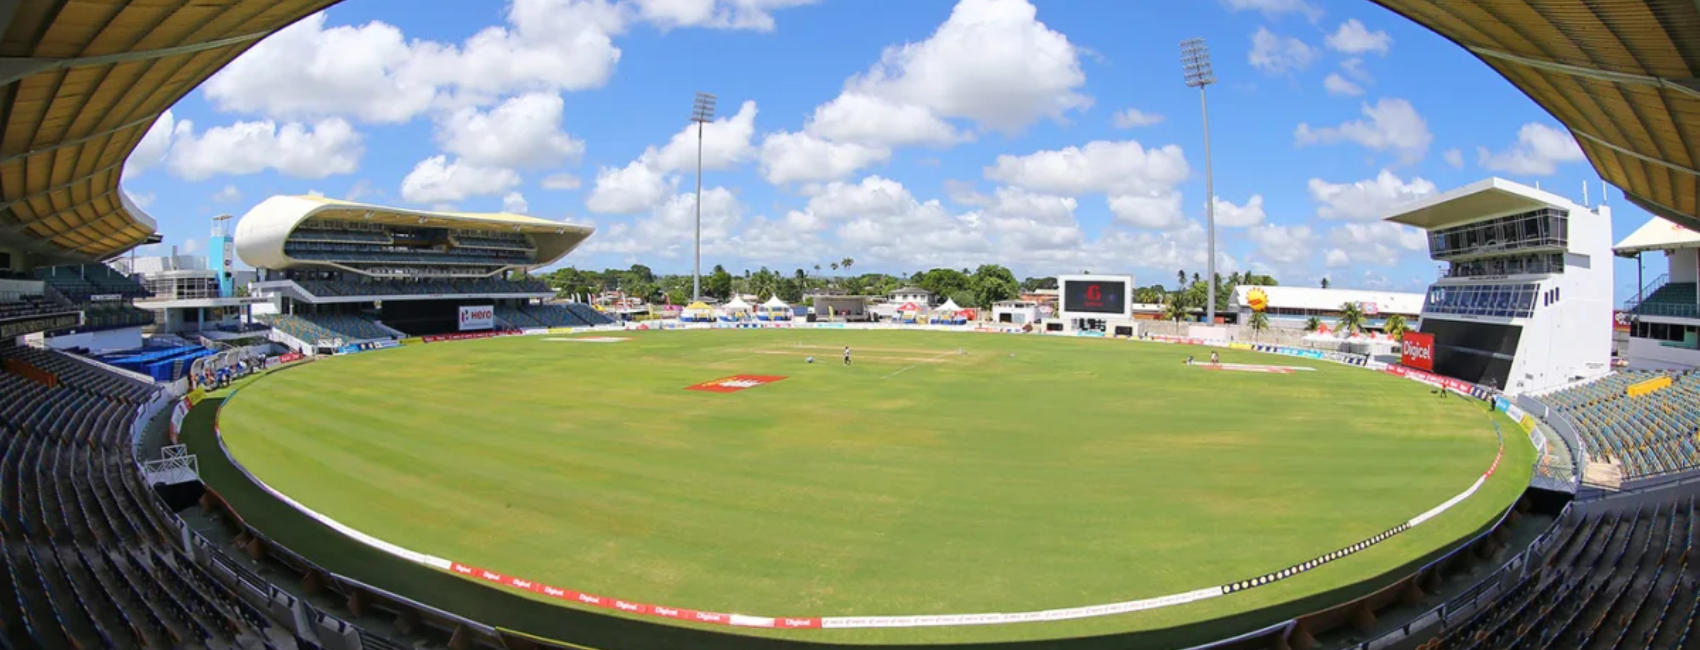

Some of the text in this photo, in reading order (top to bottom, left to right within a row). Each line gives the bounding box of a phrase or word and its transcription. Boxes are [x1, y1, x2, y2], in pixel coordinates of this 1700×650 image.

[1403, 341, 1431, 360] Digicel
[655, 606, 678, 615] Digicel
[696, 612, 720, 621] Digicel
[785, 618, 811, 627] Digicel
